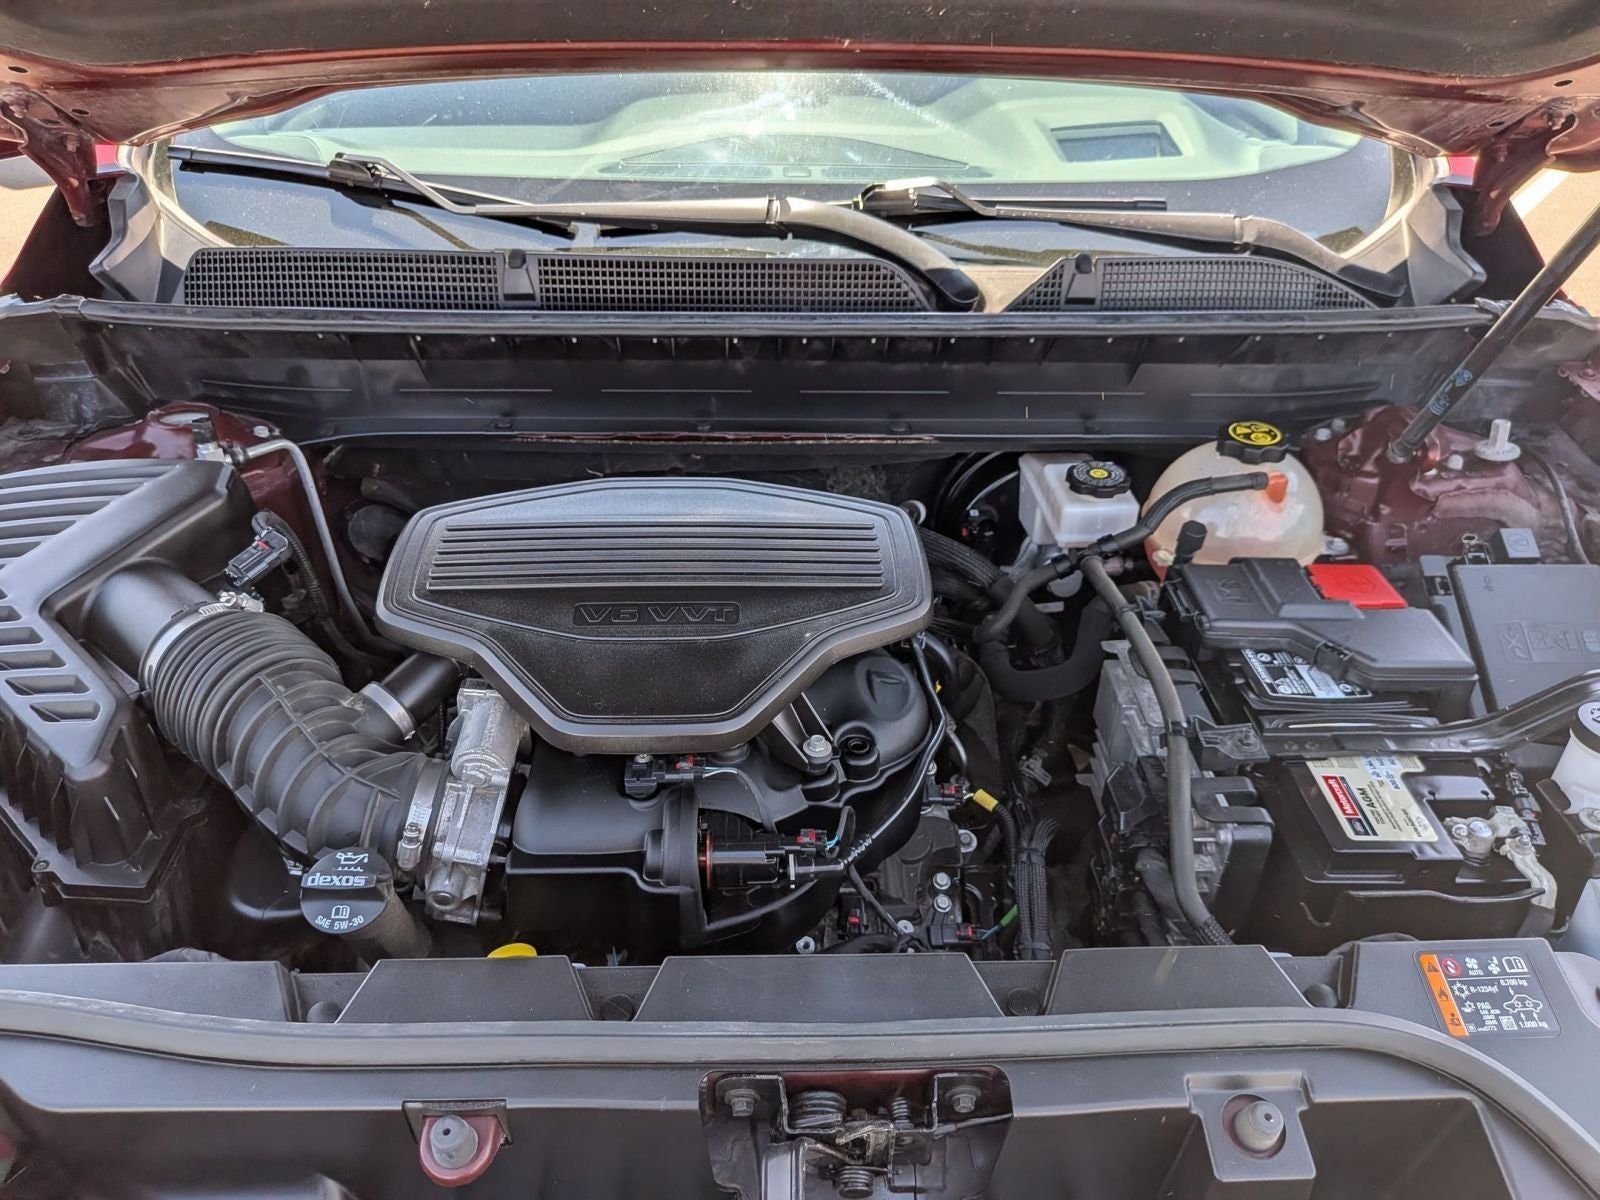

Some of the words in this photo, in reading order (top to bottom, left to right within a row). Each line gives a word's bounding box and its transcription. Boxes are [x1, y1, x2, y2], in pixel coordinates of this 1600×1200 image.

[580, 606, 638, 623] V6
[647, 606, 734, 623] VVT
[1327, 778, 1355, 815] Motorcraft
[1356, 787, 1378, 810] AGM
[306, 872, 369, 887] dexos
[315, 915, 332, 929] SAE
[333, 915, 365, 931] 5W-30
[1470, 985, 1499, 994] R-1234yf
[1499, 978, 1518, 987] 0.700
[1476, 1002, 1492, 1010] PAG
